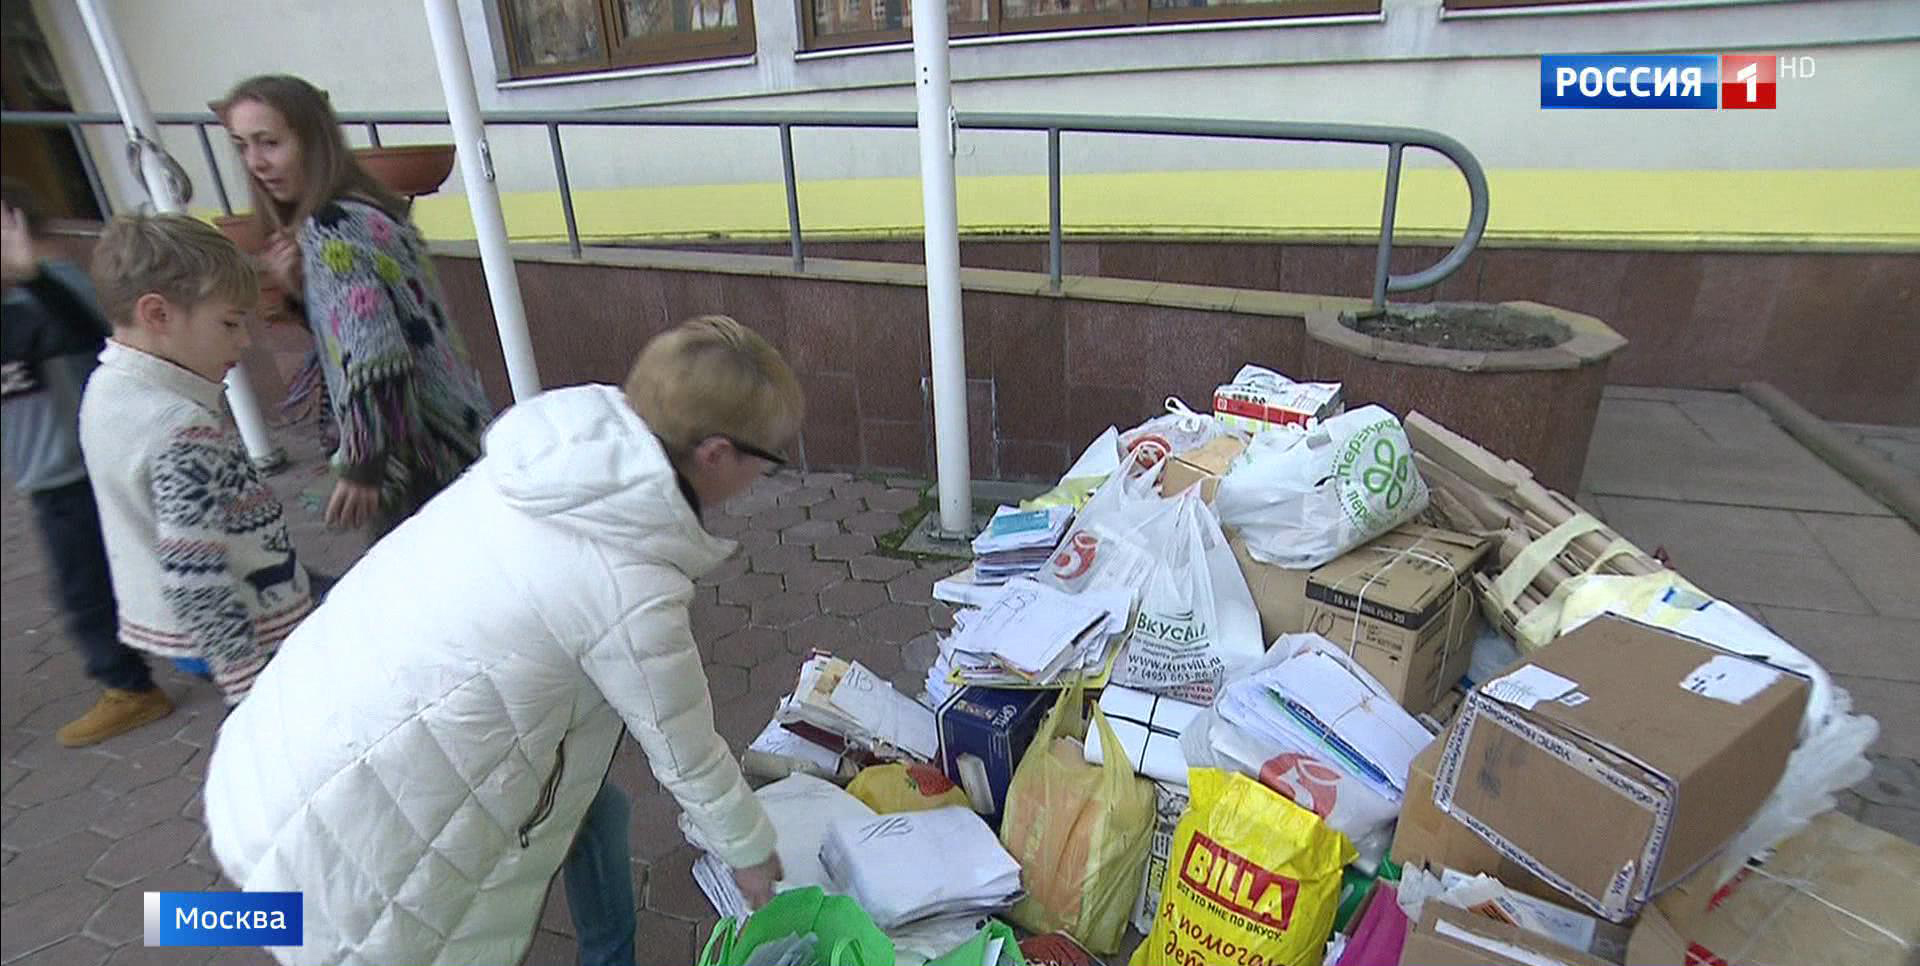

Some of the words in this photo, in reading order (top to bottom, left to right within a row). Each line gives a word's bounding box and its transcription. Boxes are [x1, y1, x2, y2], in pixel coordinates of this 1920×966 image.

[1186, 842, 1284, 921] BILLA
[1179, 913, 1277, 966] помога
[1207, 903, 1227, 920] МНЕ
[1229, 914, 1245, 928] ПО
